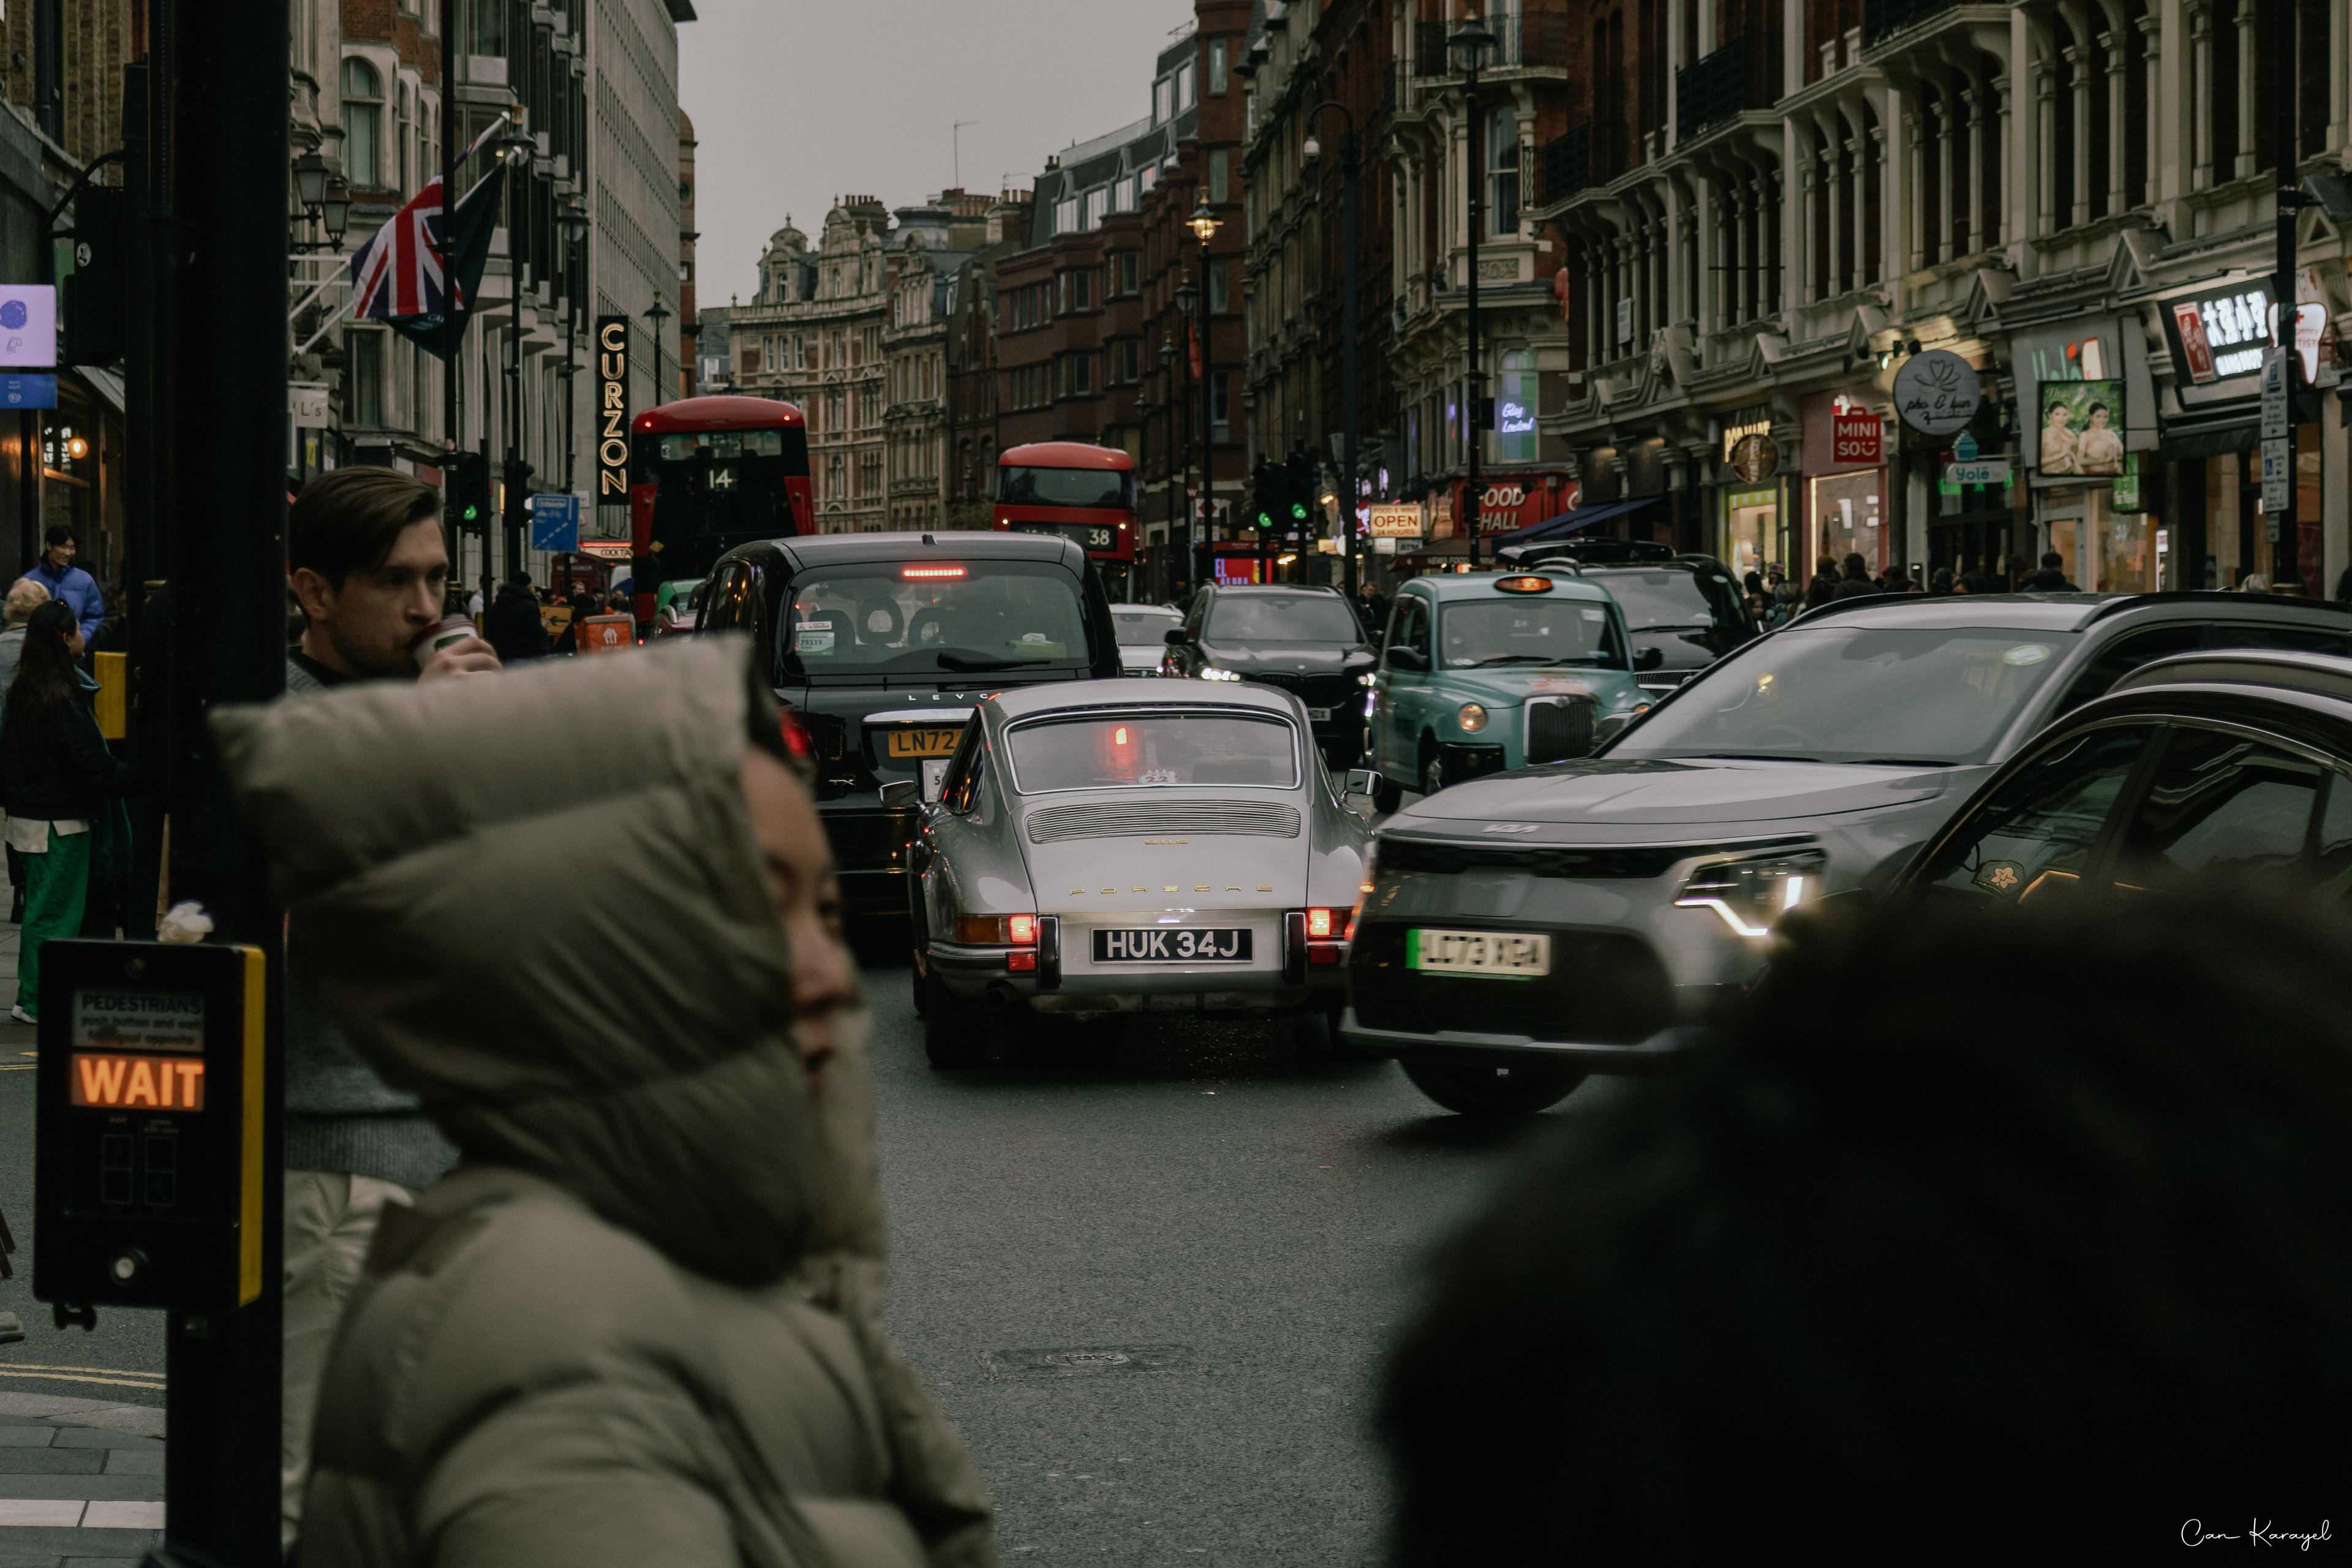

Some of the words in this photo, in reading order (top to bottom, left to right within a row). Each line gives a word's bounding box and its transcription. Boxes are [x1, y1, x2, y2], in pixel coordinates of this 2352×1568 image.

[600, 323, 628, 495] CURZON
[1838, 423, 1877, 437] MINI
[709, 469, 733, 489] 14
[1374, 515, 1418, 527] OPEN
[1480, 511, 1520, 530] HALL
[1089, 529, 1110, 545] 38
[897, 731, 956, 752] LN72
[1069, 886, 1273, 895] PORSCHE
[1107, 932, 1169, 958] HUK
[1177, 931, 1238, 957] 34J
[83, 994, 202, 1014] PEDESTRIANS
[154, 1019, 175, 1028] and
[80, 1058, 204, 1108] WAIT
